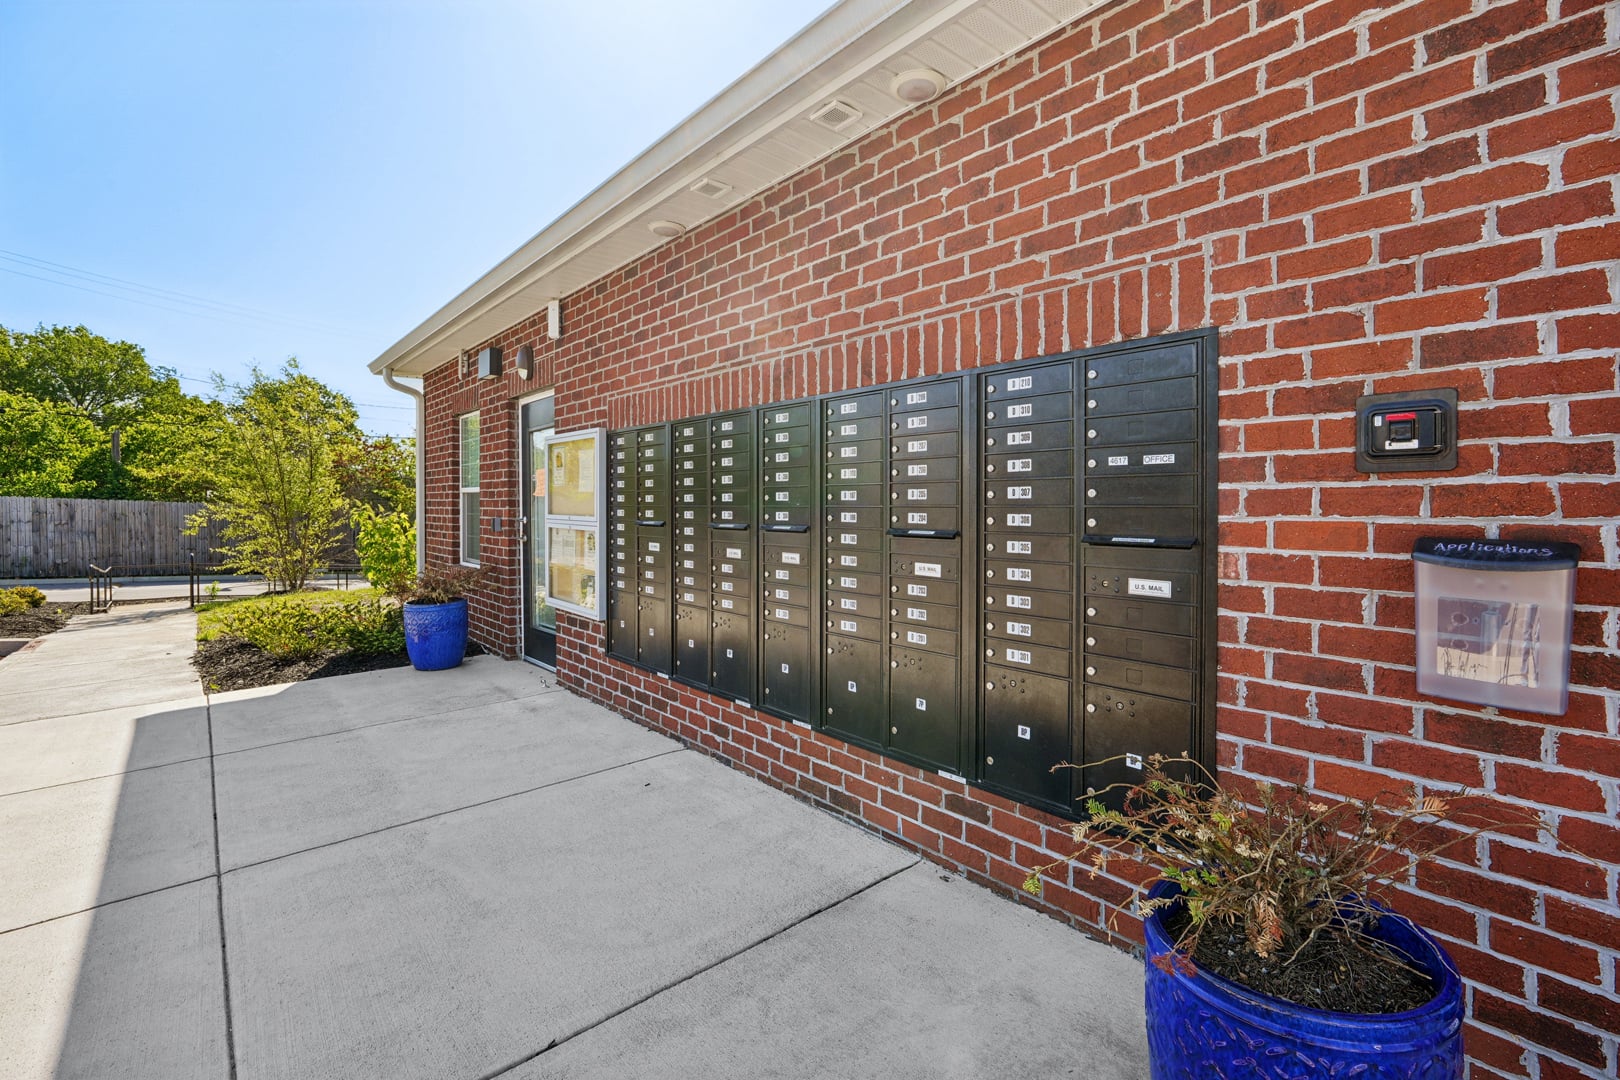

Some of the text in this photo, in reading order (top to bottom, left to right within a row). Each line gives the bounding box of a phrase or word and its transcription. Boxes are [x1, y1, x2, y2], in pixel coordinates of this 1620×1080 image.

[1020, 377, 1031, 388] 210
[1020, 405, 1031, 415] 310
[1144, 455, 1174, 464] OFFICE
[1020, 487, 1031, 497] 307
[1019, 542, 1030, 552] 305
[1433, 542, 1555, 557] Applications
[1134, 583, 1147, 591] U.S.
